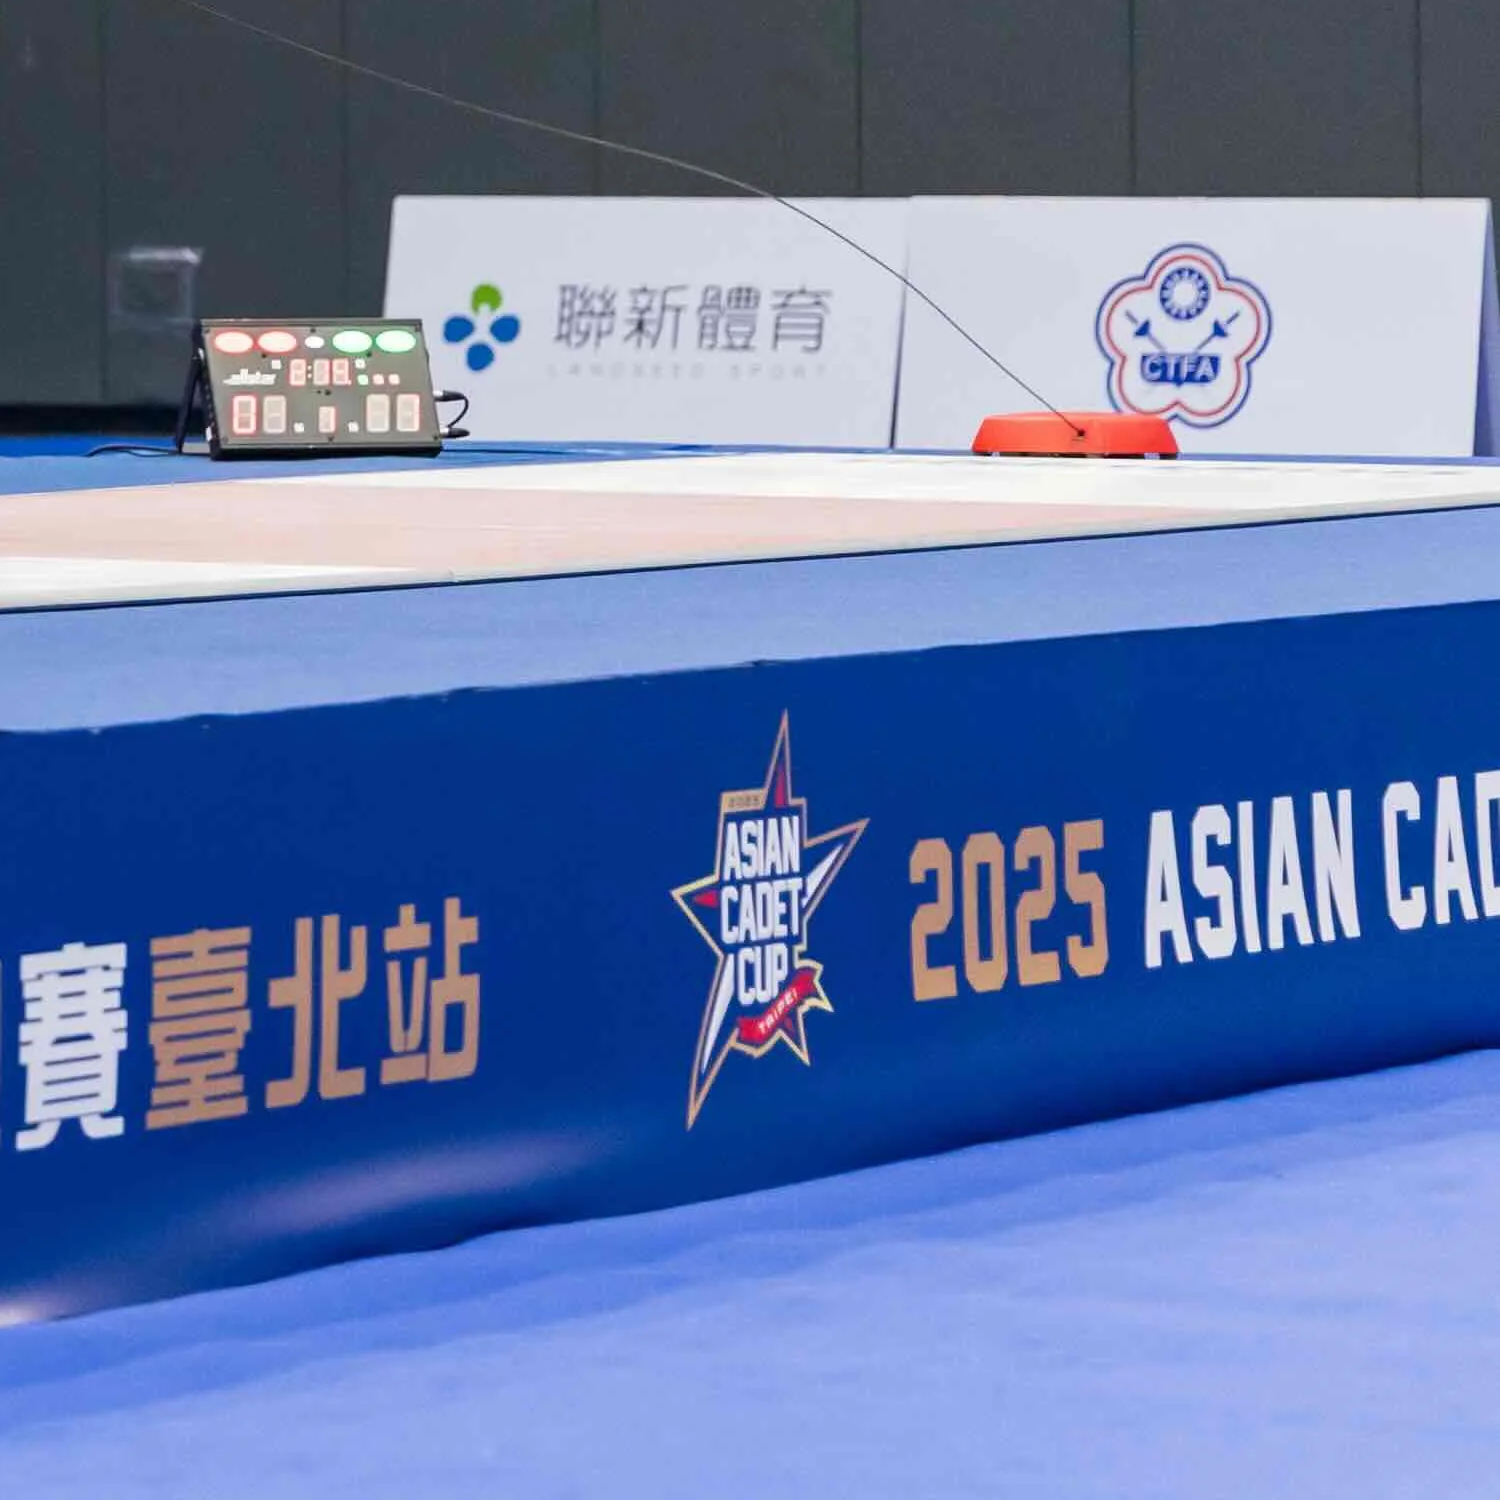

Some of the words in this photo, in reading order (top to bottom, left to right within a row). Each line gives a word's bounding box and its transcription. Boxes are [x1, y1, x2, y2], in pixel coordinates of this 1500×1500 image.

[553, 283, 835, 353] 聯新體育
[1146, 355, 1216, 383] CTFA
[722, 815, 800, 881] ASIAN
[720, 878, 804, 944] CADET
[909, 819, 1109, 1002] 2025
[1145, 788, 1362, 969] ASIAN
[737, 942, 789, 1008] CUP
